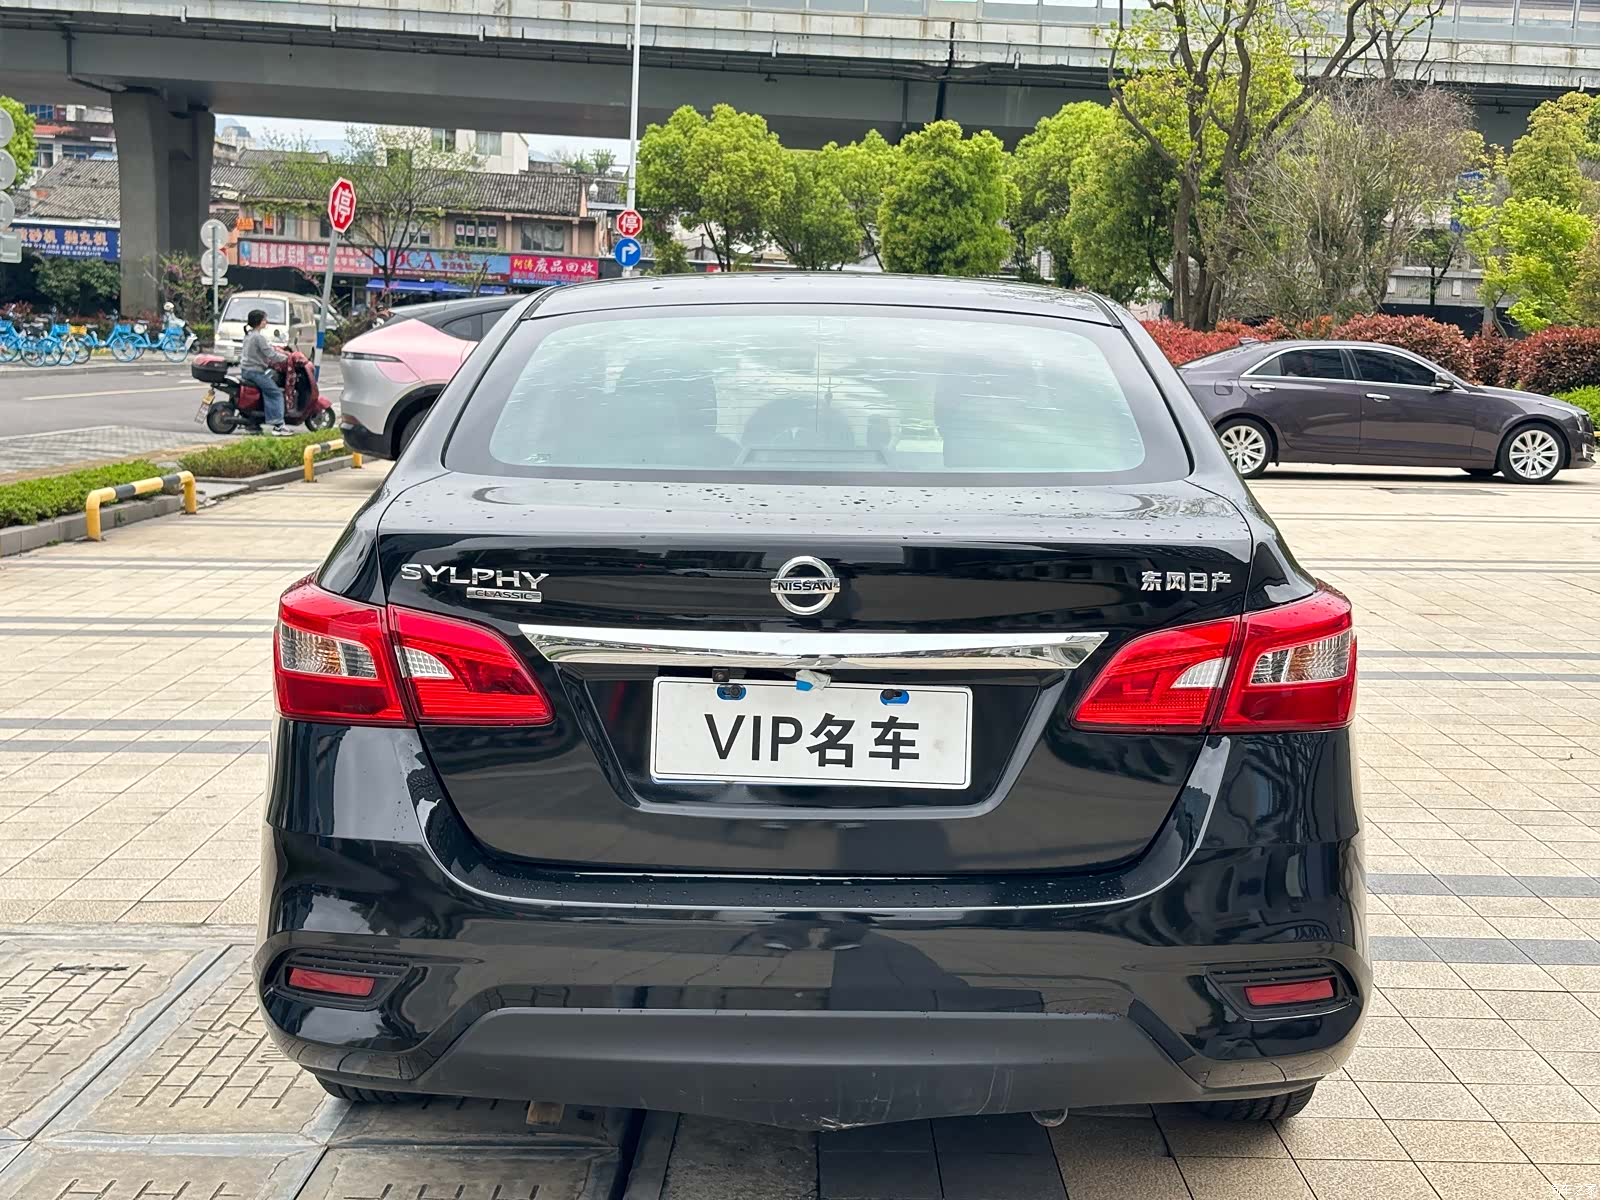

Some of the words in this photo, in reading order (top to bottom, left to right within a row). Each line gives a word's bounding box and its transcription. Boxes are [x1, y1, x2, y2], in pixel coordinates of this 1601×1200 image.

[333, 186, 353, 224] 停
[620, 214, 639, 233] 停
[401, 563, 550, 590] SYLPHY
[777, 581, 833, 591] NISSAN
[1140, 570, 1232, 592] 东风日产
[475, 589, 534, 601] CLASSIC
[704, 712, 920, 770] VIP名车
